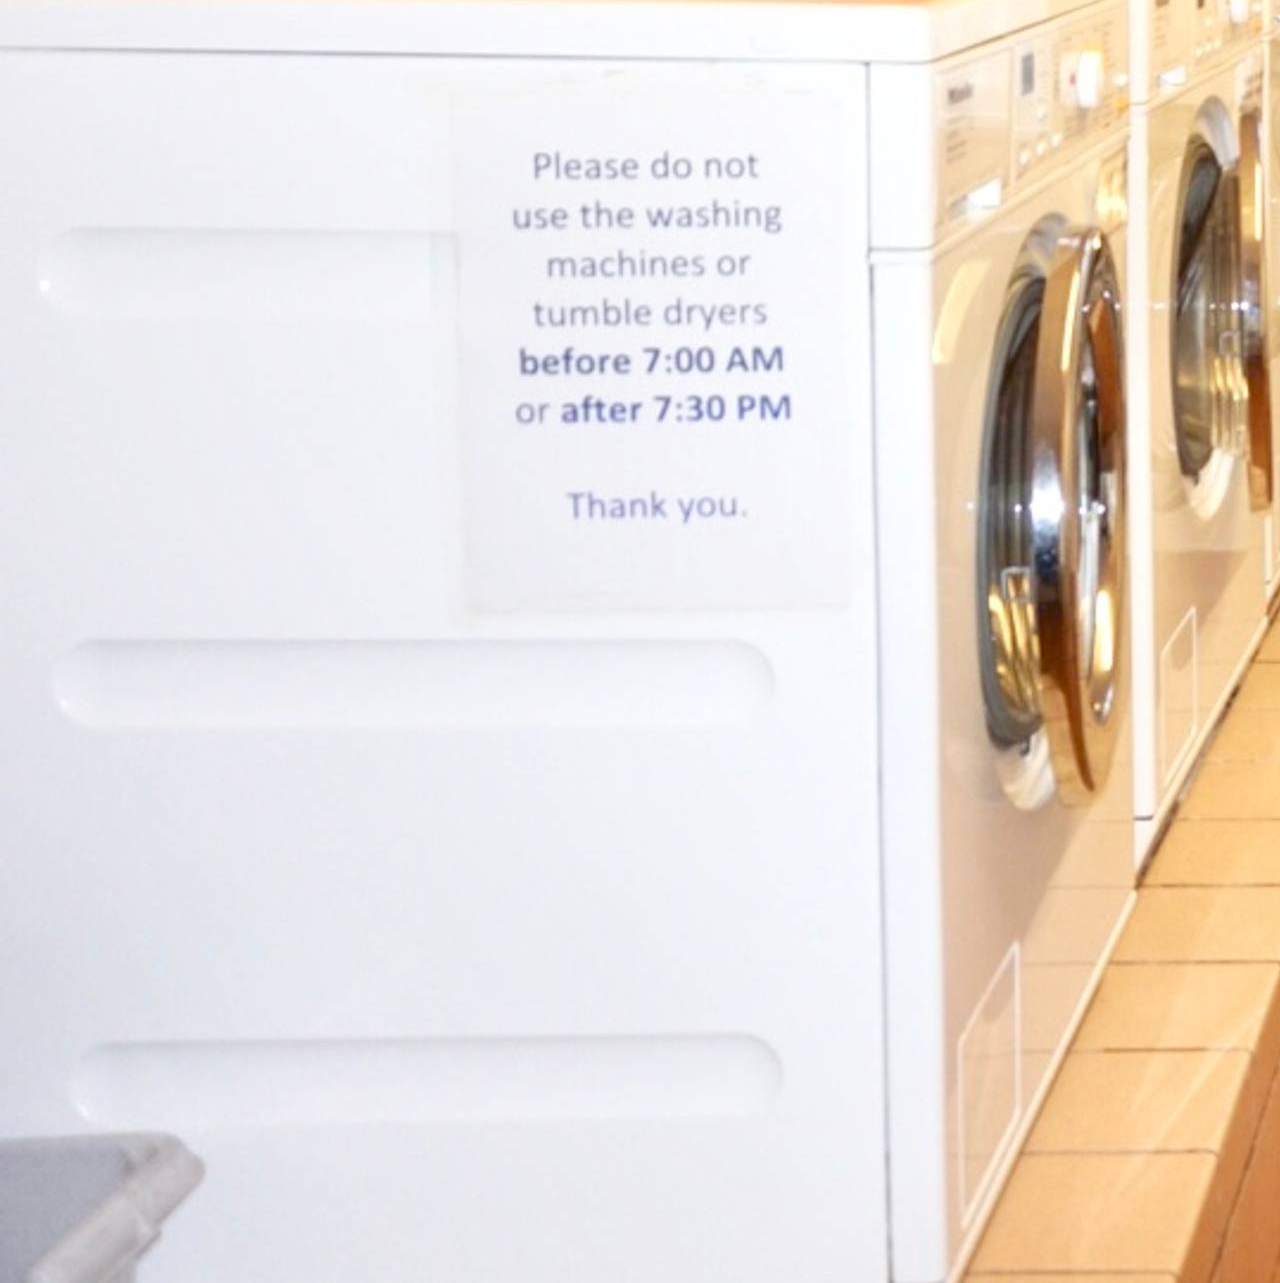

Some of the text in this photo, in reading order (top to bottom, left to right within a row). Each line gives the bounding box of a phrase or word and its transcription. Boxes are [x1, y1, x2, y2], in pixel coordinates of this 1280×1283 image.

[533, 151, 758, 180] Please do not
[513, 200, 782, 234] use the washing
[548, 250, 750, 278] machines or
[534, 297, 767, 330] tumble dryers
[519, 346, 784, 376] before 7:00 AM
[516, 394, 791, 424] or after 7:30 PM
[567, 491, 747, 523] Thank you.
